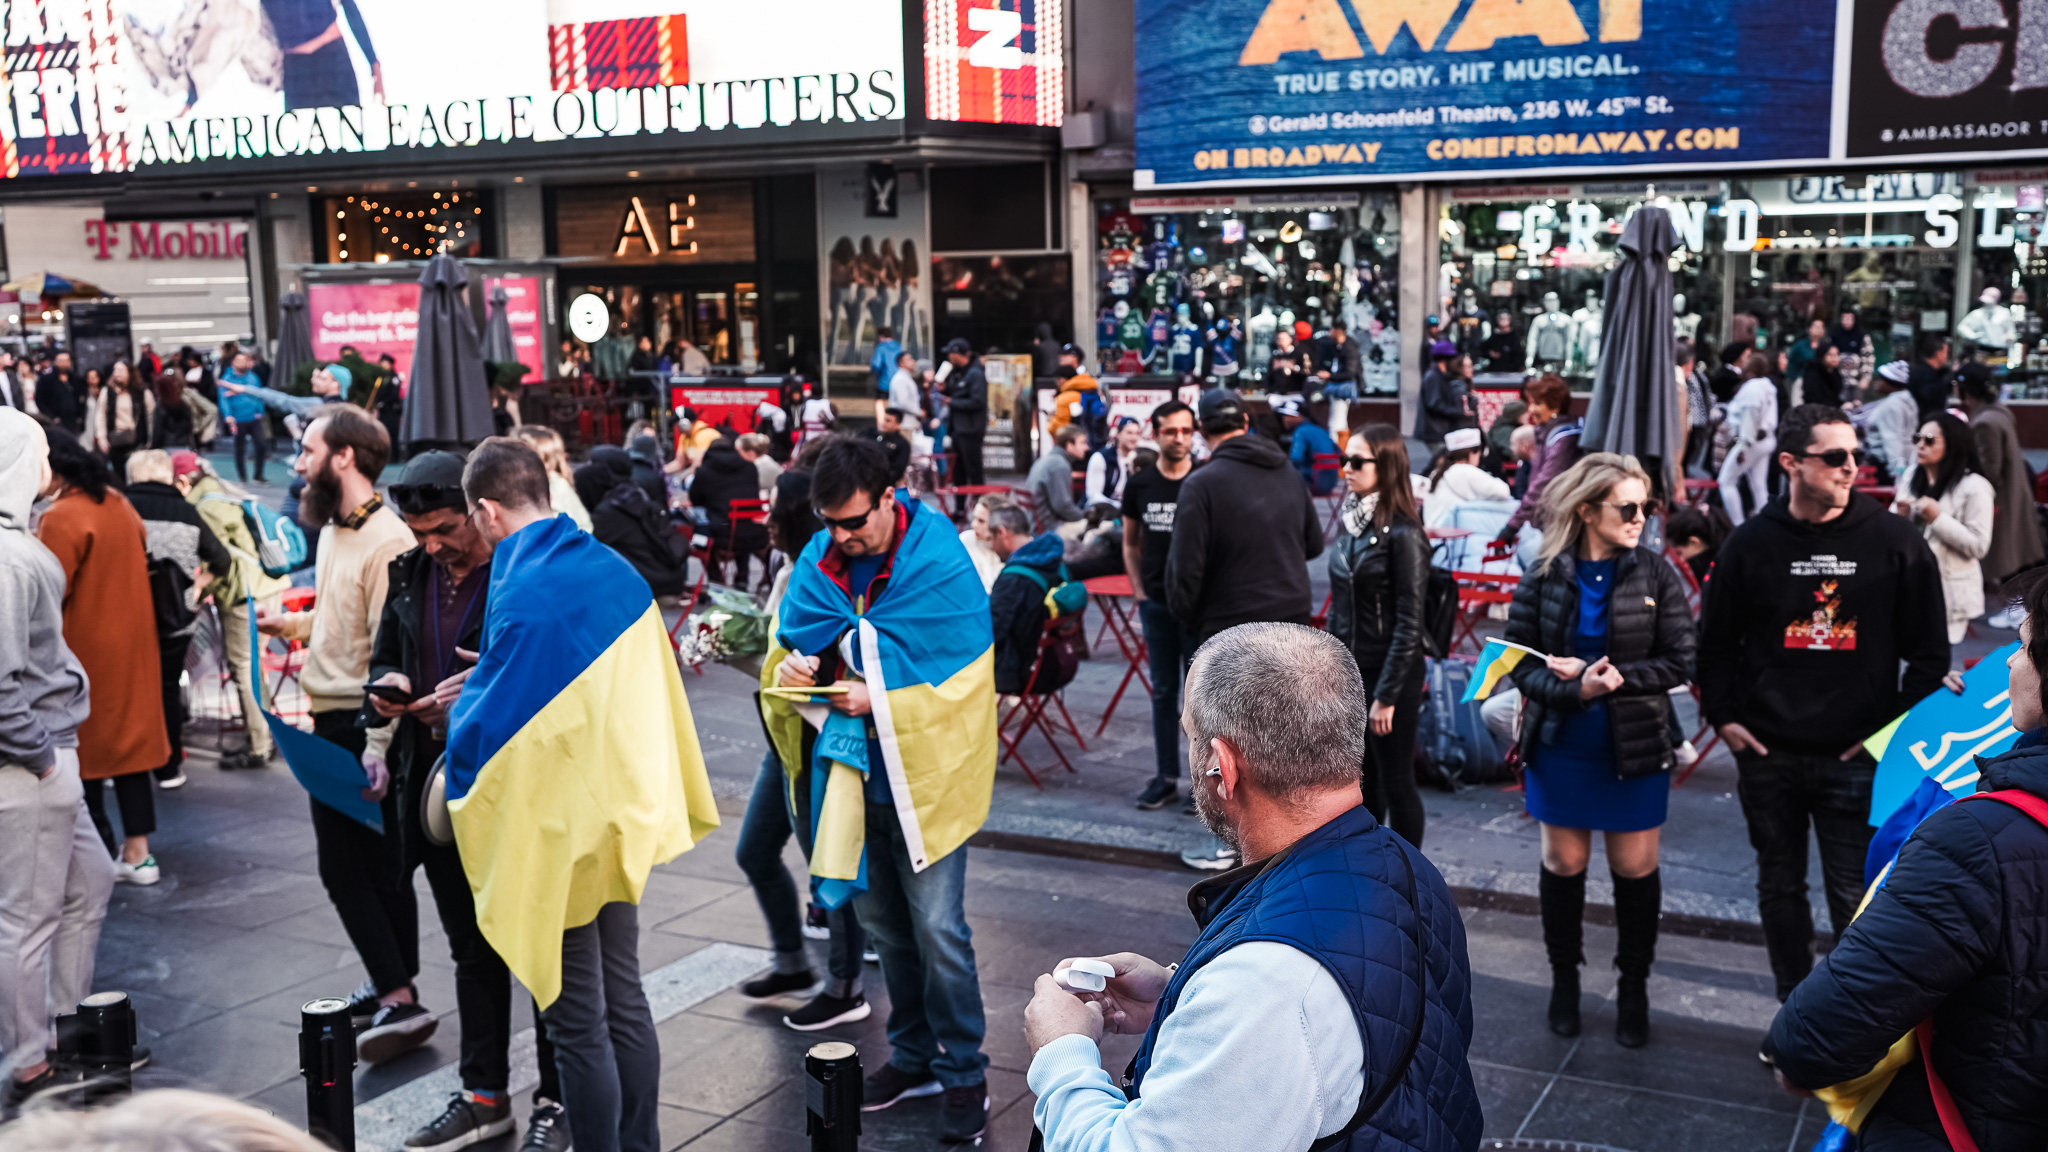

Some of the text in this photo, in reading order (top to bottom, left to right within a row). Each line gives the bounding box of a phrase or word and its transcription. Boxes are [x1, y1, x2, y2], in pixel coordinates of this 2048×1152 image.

[1274, 54, 1640, 95] TRUE STORY. HIT MUSICAL.
[140, 70, 896, 162] AMERICAN EAGLE OUTFITTERS
[1268, 113, 1328, 133] Gerald
[1331, 107, 1434, 129] Schoenfeld
[1438, 104, 1518, 124] Theatre,
[1522, 100, 1560, 120] 236
[1564, 99, 1593, 117] W.
[1644, 95, 1674, 114] St.
[1897, 121, 2032, 142] AMBASSADOR
[1193, 127, 1741, 170] ON BROADWAY COMEFROMAWAY.COM
[1521, 199, 1759, 253] GRND
